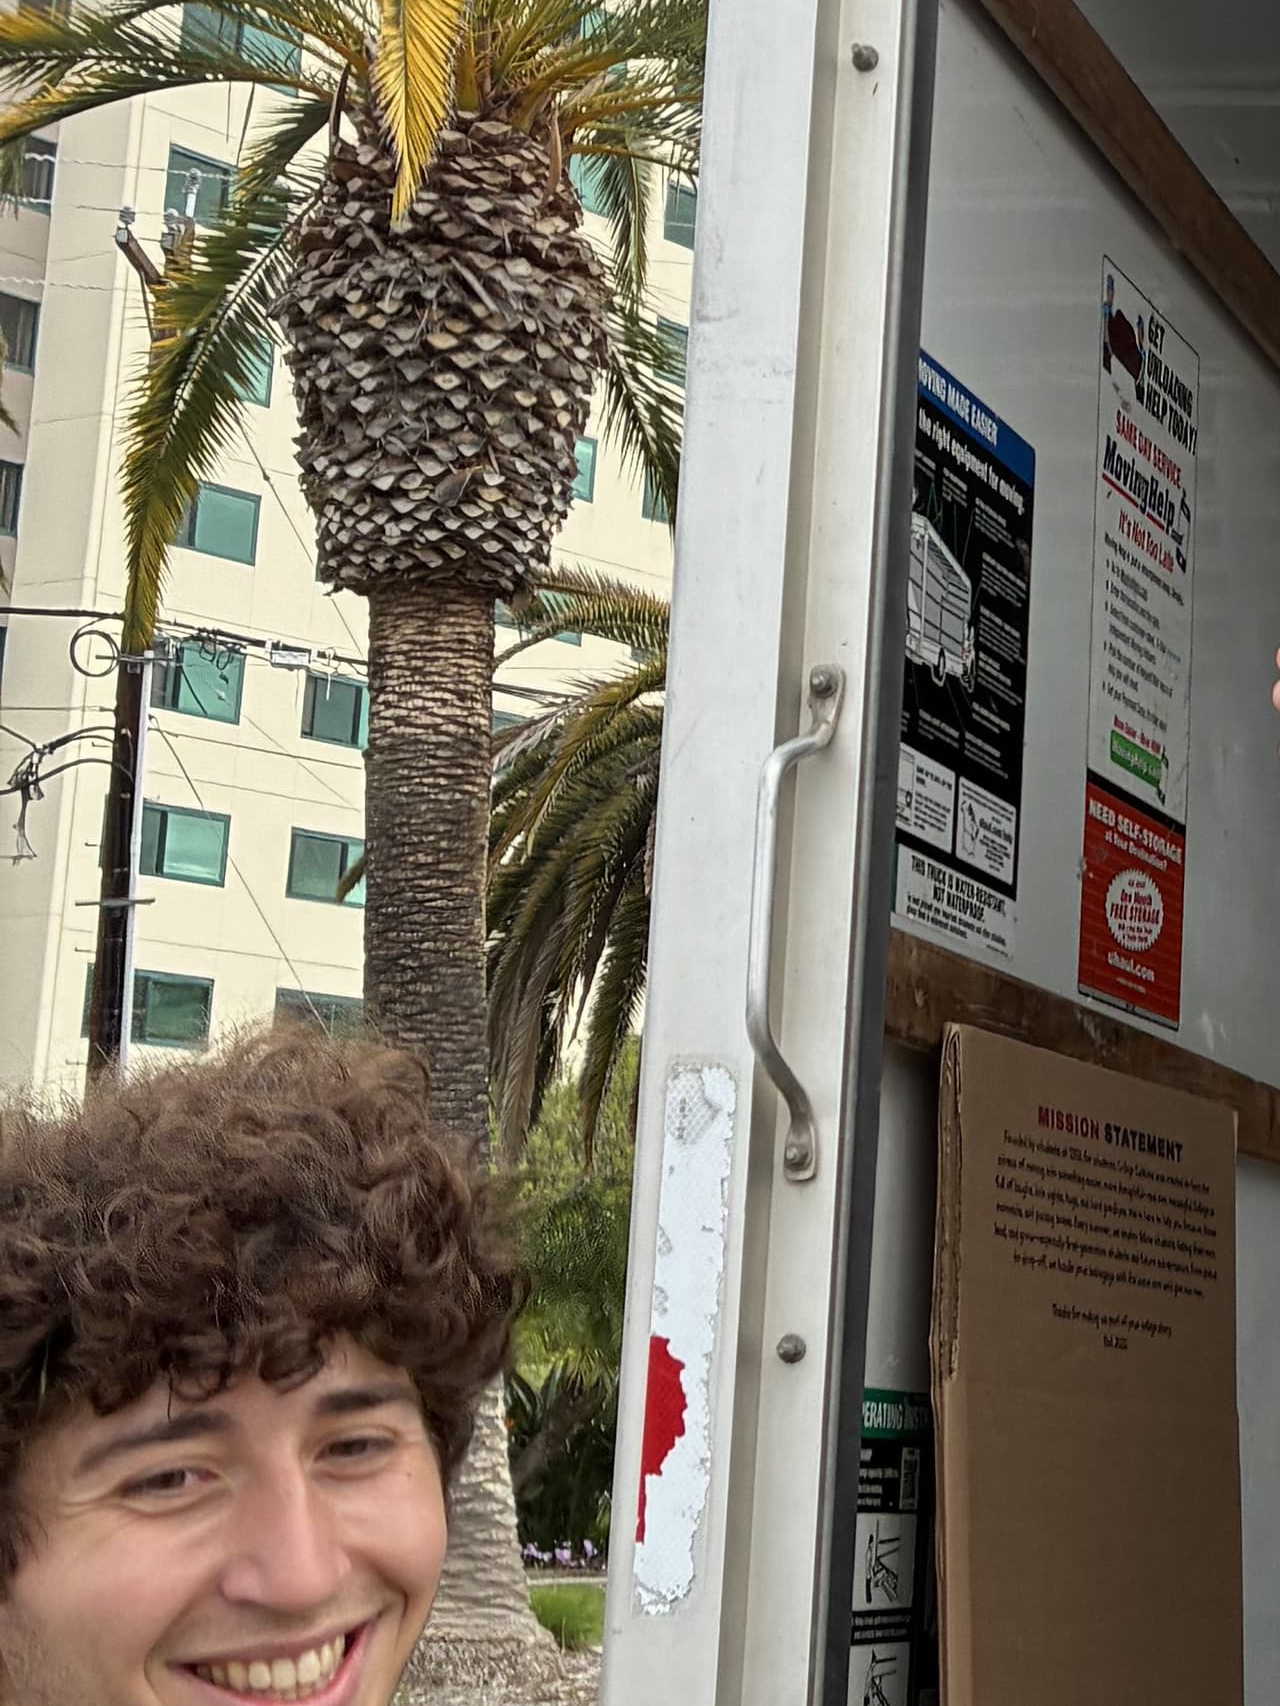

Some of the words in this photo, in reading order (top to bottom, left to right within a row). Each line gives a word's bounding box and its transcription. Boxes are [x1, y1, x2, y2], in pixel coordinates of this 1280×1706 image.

[1149, 314, 1165, 355] GET
[1147, 348, 1193, 419] UNLOADING
[919, 407, 932, 437] the
[948, 384, 970, 424] MADE
[1146, 383, 1168, 425] HELP
[1168, 404, 1198, 456] TODAY!
[1088, 798, 1116, 830] NEED
[1117, 814, 1182, 865] SELF-STORAGE
[911, 854, 926, 878] THIS
[926, 862, 946, 886] TRUCK
[947, 873, 954, 891] IS
[932, 883, 946, 903] NOT
[1107, 951, 1156, 982] uhaul.com
[1037, 1105, 1099, 1140] MISSION
[1103, 1122, 1183, 1163] STATEMENT
